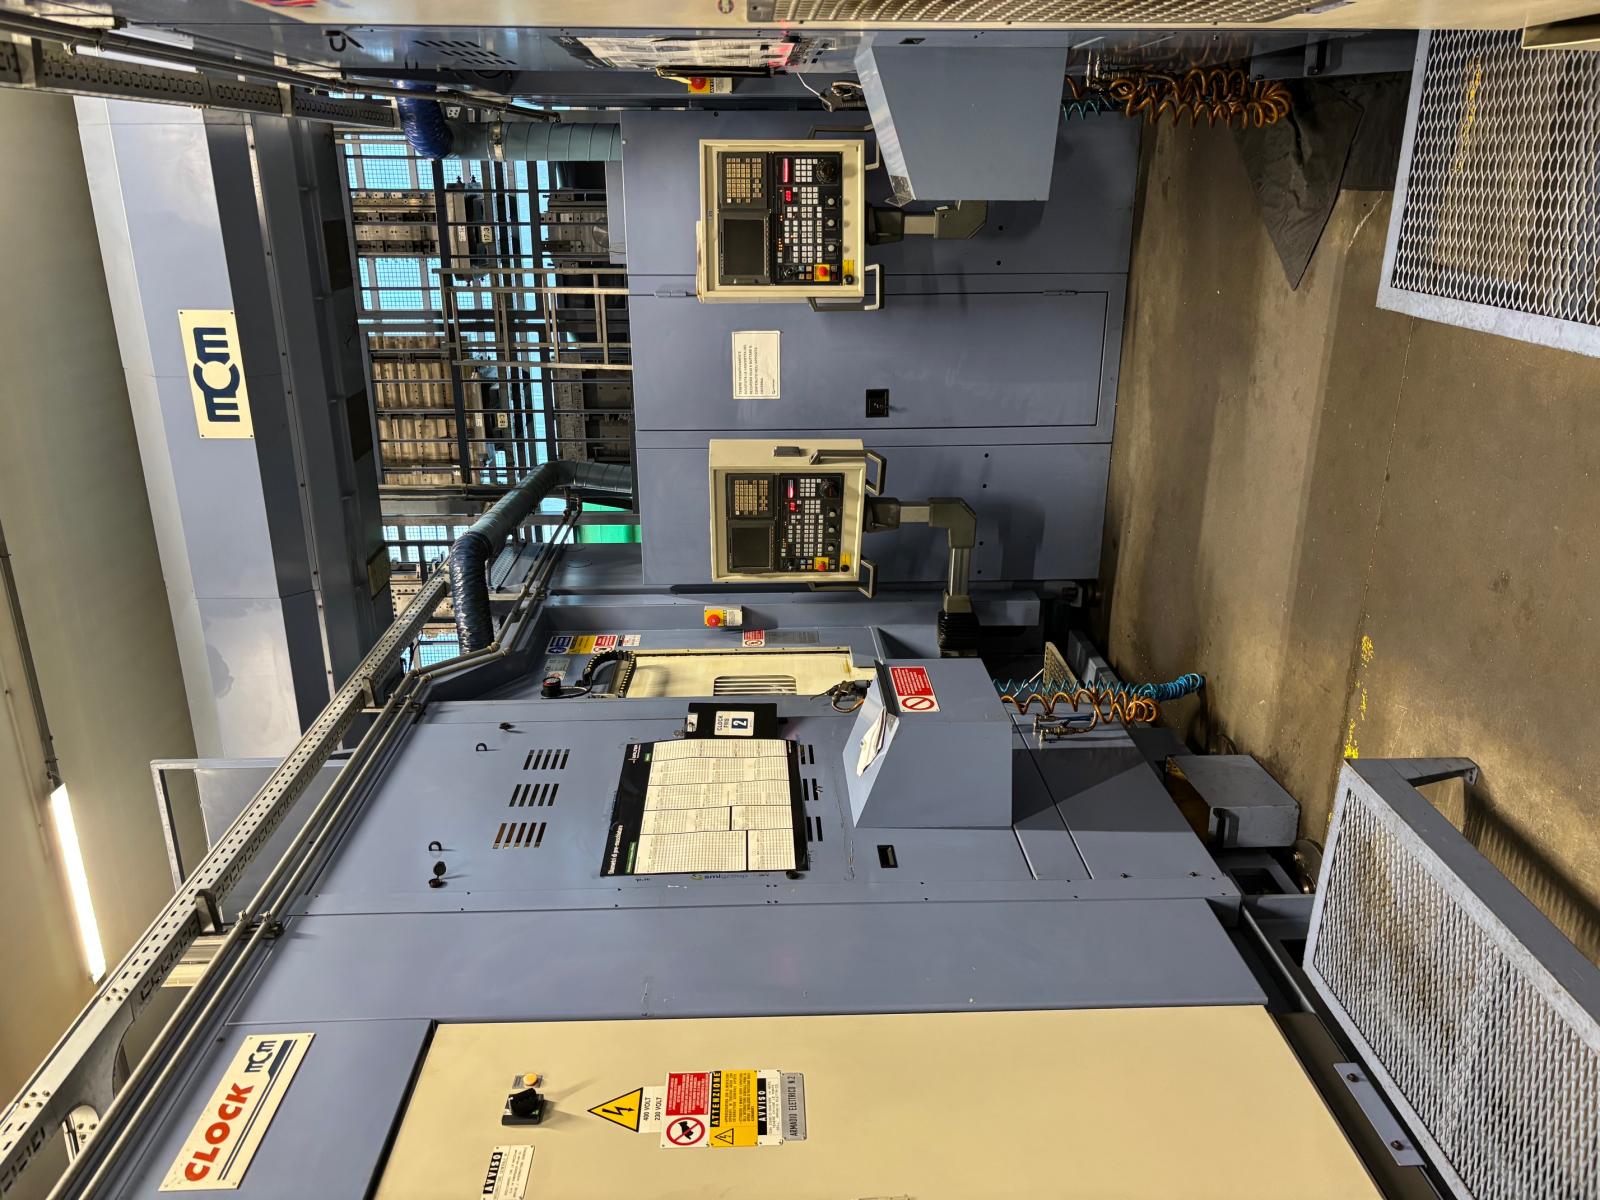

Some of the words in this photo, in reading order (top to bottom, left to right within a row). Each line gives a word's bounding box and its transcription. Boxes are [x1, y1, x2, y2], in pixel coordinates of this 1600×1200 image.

[787, 1076, 795, 1084] N.2
[712, 1072, 720, 1126] ATTENZIONE
[758, 1090, 766, 1121] AVVISO
[788, 1087, 797, 1110] ELETTRICO
[184, 1082, 254, 1182] CLOCK
[789, 1114, 798, 1136] ARMADIO
[484, 1154, 501, 1192] AVVISO
